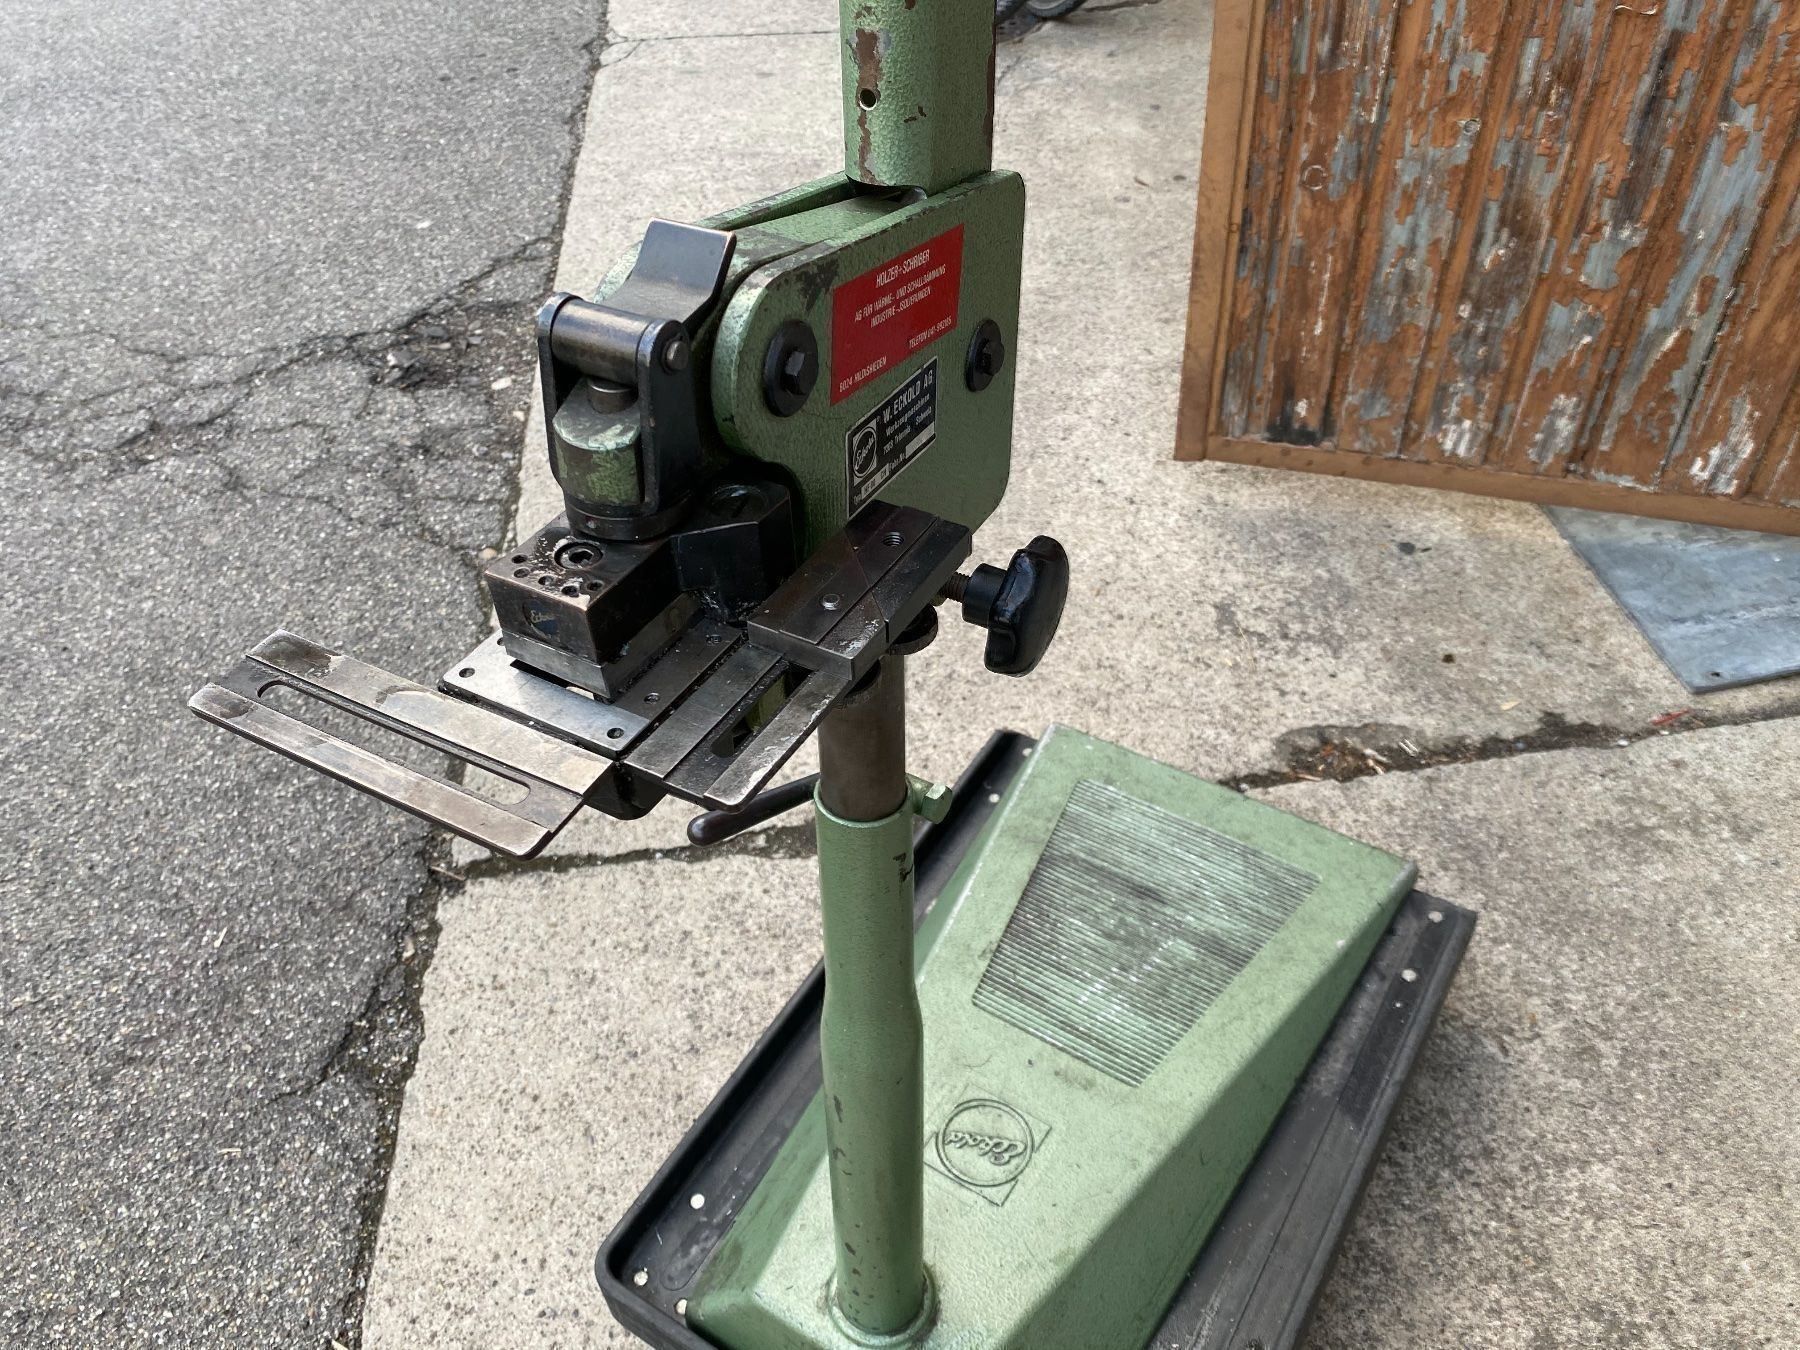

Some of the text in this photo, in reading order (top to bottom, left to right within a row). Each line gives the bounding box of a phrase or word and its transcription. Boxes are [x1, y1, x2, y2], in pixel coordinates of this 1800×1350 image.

[854, 310, 862, 322] AG
[863, 301, 873, 318] FÜR
[896, 287, 906, 299] UND
[909, 332, 928, 349] TELEFON
[883, 369, 933, 424] W. ECKOLD AG
